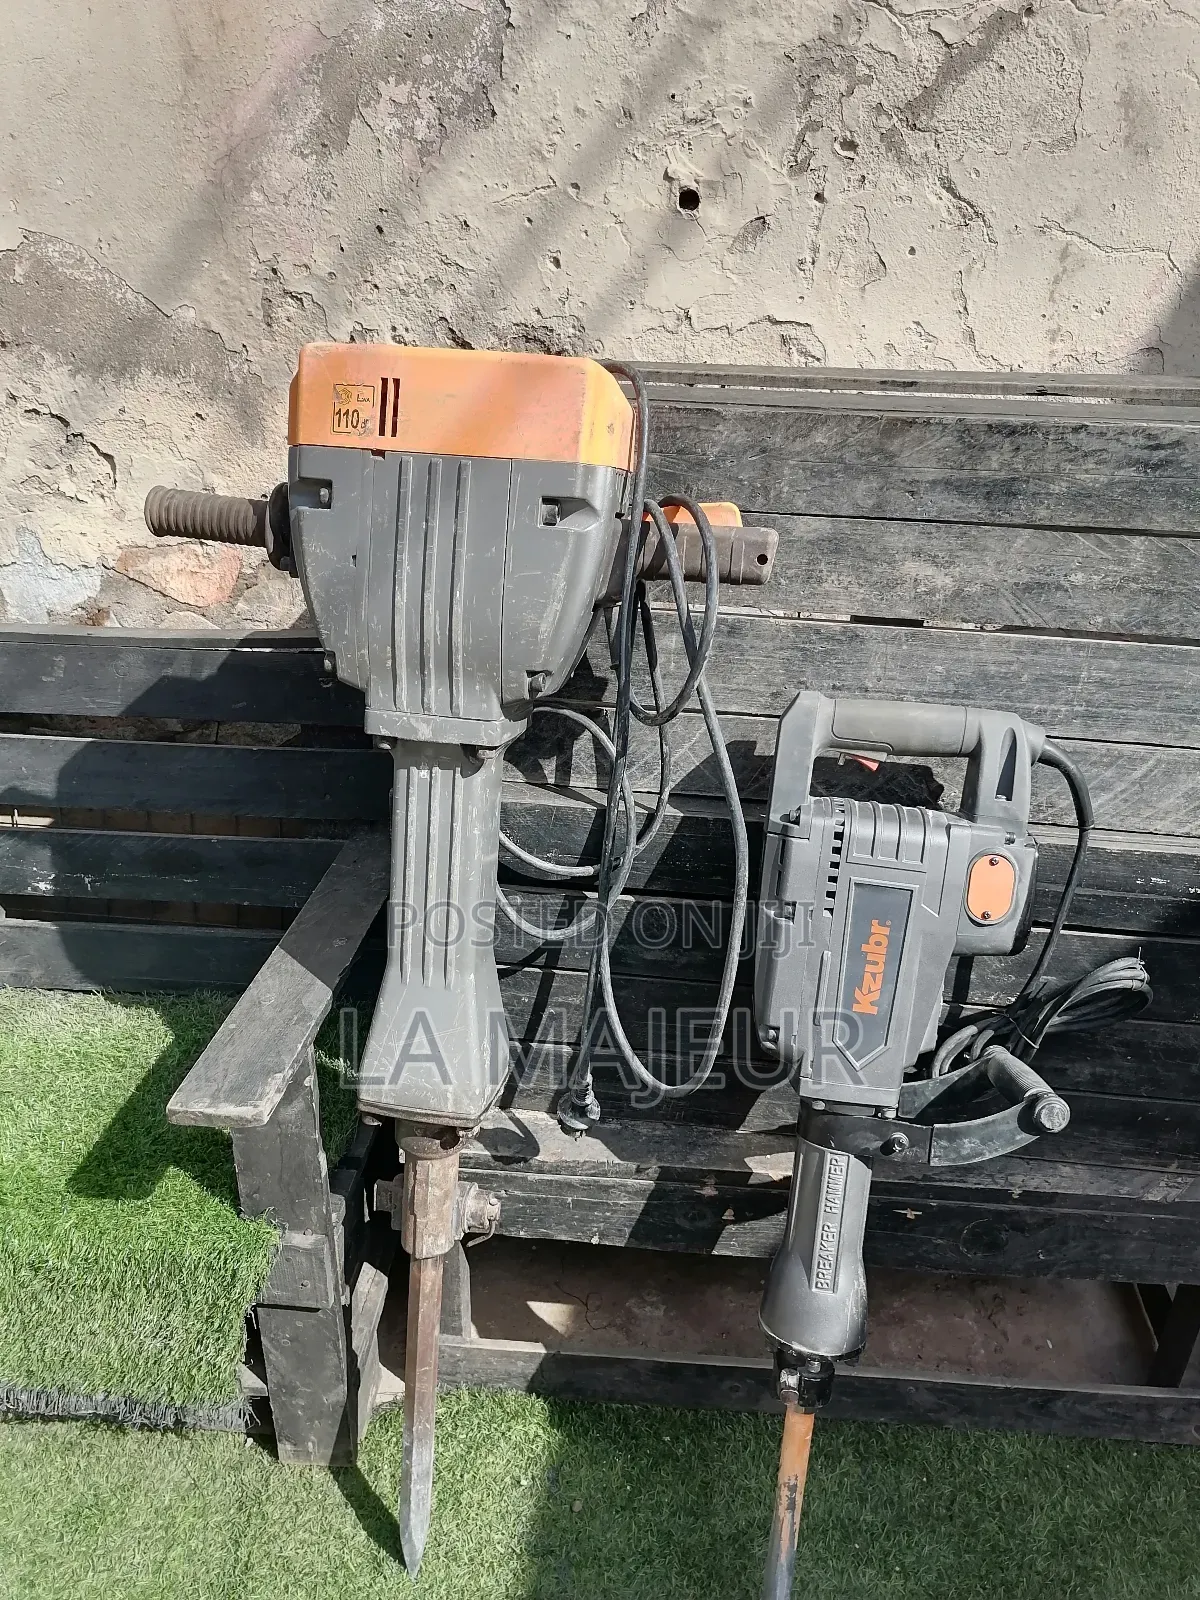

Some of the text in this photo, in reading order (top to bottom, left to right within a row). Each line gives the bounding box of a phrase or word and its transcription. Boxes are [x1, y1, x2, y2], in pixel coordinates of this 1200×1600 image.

[335, 407, 360, 429] 110
[852, 920, 890, 1015] Kzubr
[816, 1156, 846, 1289] BREAKER HAMMER
